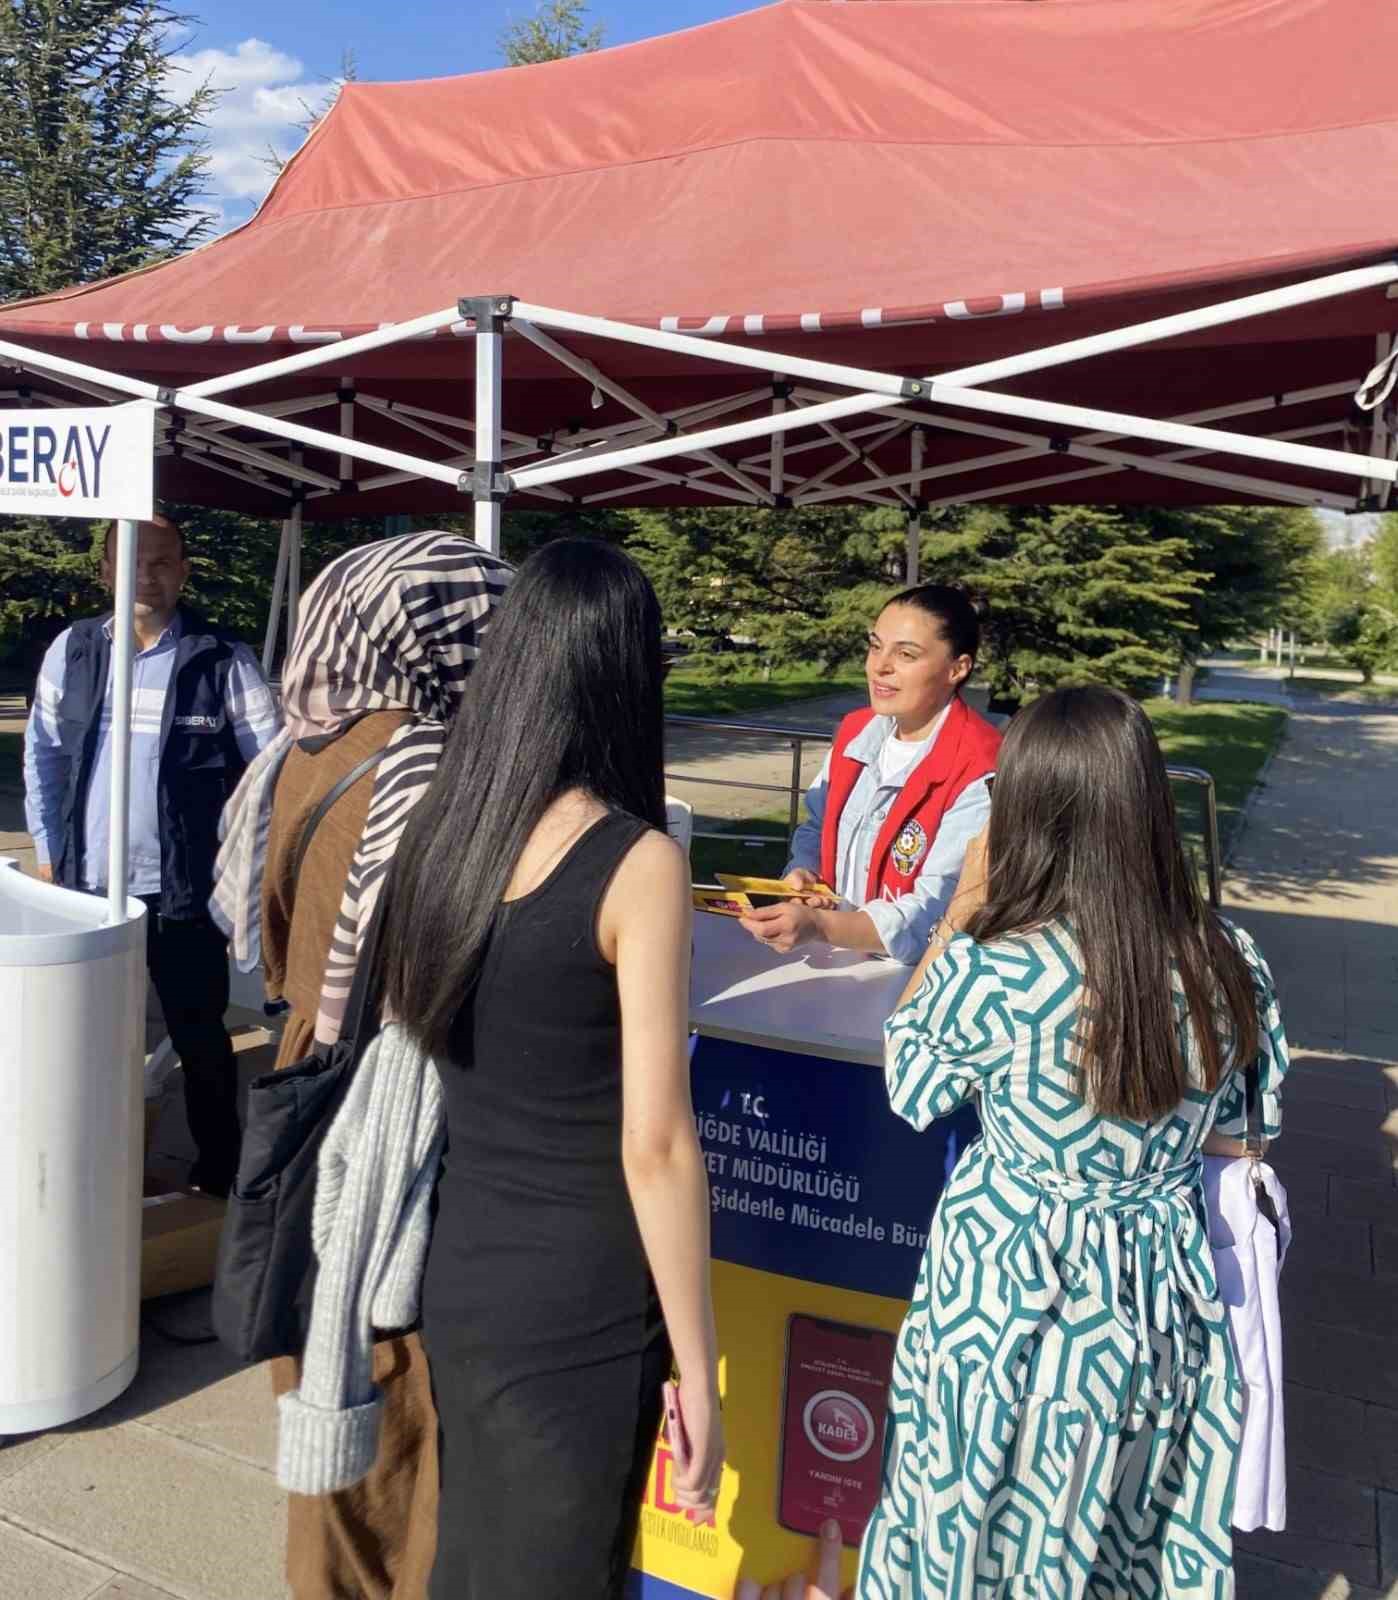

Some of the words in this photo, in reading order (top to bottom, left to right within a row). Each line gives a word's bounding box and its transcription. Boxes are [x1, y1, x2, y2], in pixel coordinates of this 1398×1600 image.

[0, 424, 111, 498] ERAY
[698, 1111, 741, 1146] İĞDE
[747, 1129, 827, 1164] VALİLİĞİ
[732, 1156, 860, 1203] MÜDÜRLÜĞÜ
[711, 1185, 785, 1221] Şiddetle
[791, 1203, 886, 1242] Mücadele
[892, 1222, 928, 1249] Bür
